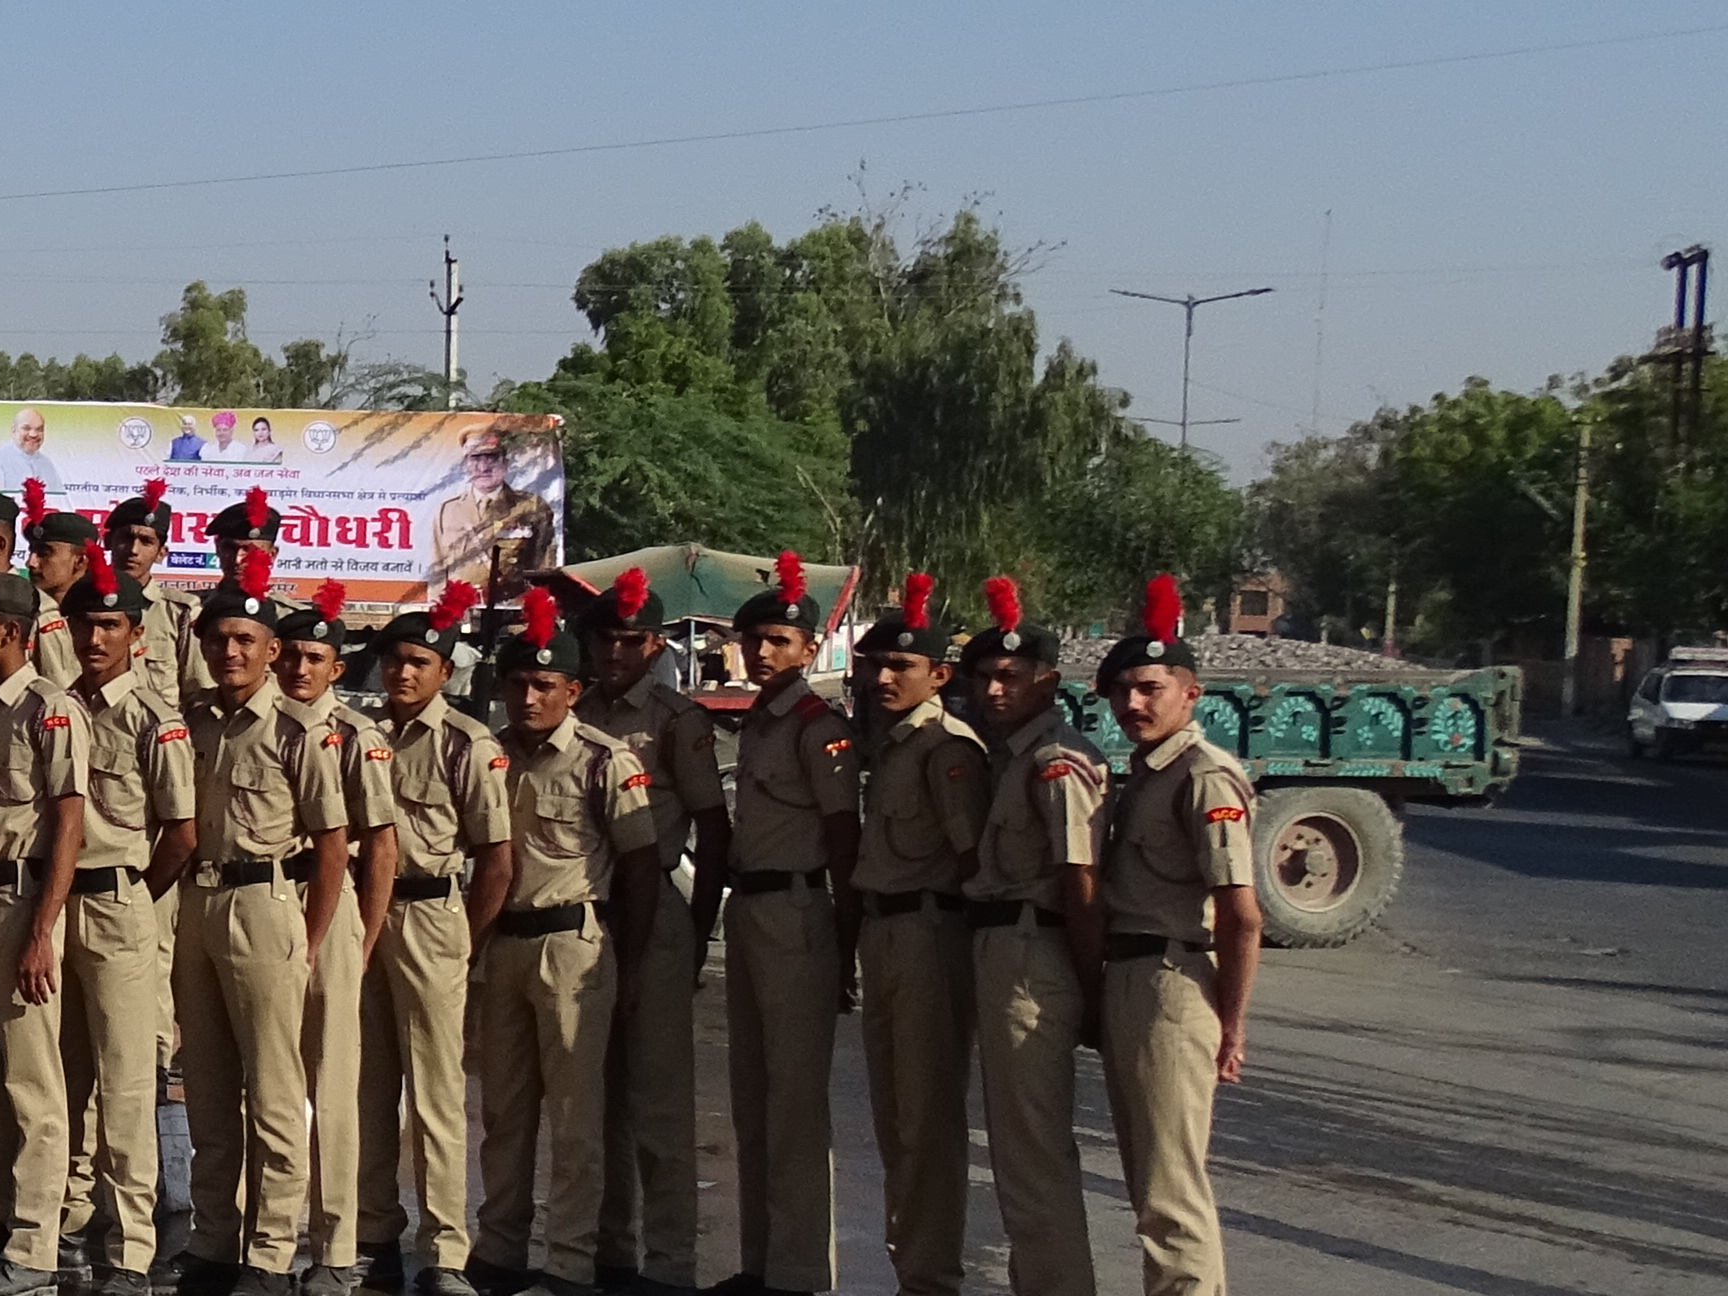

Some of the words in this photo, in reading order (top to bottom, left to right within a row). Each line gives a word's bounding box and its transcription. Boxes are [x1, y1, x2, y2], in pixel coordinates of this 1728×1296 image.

[63, 481, 99, 493] भारतीय
[102, 483, 128, 494] जनता
[280, 505, 413, 550] चौधरी
[346, 558, 379, 572] विजय
